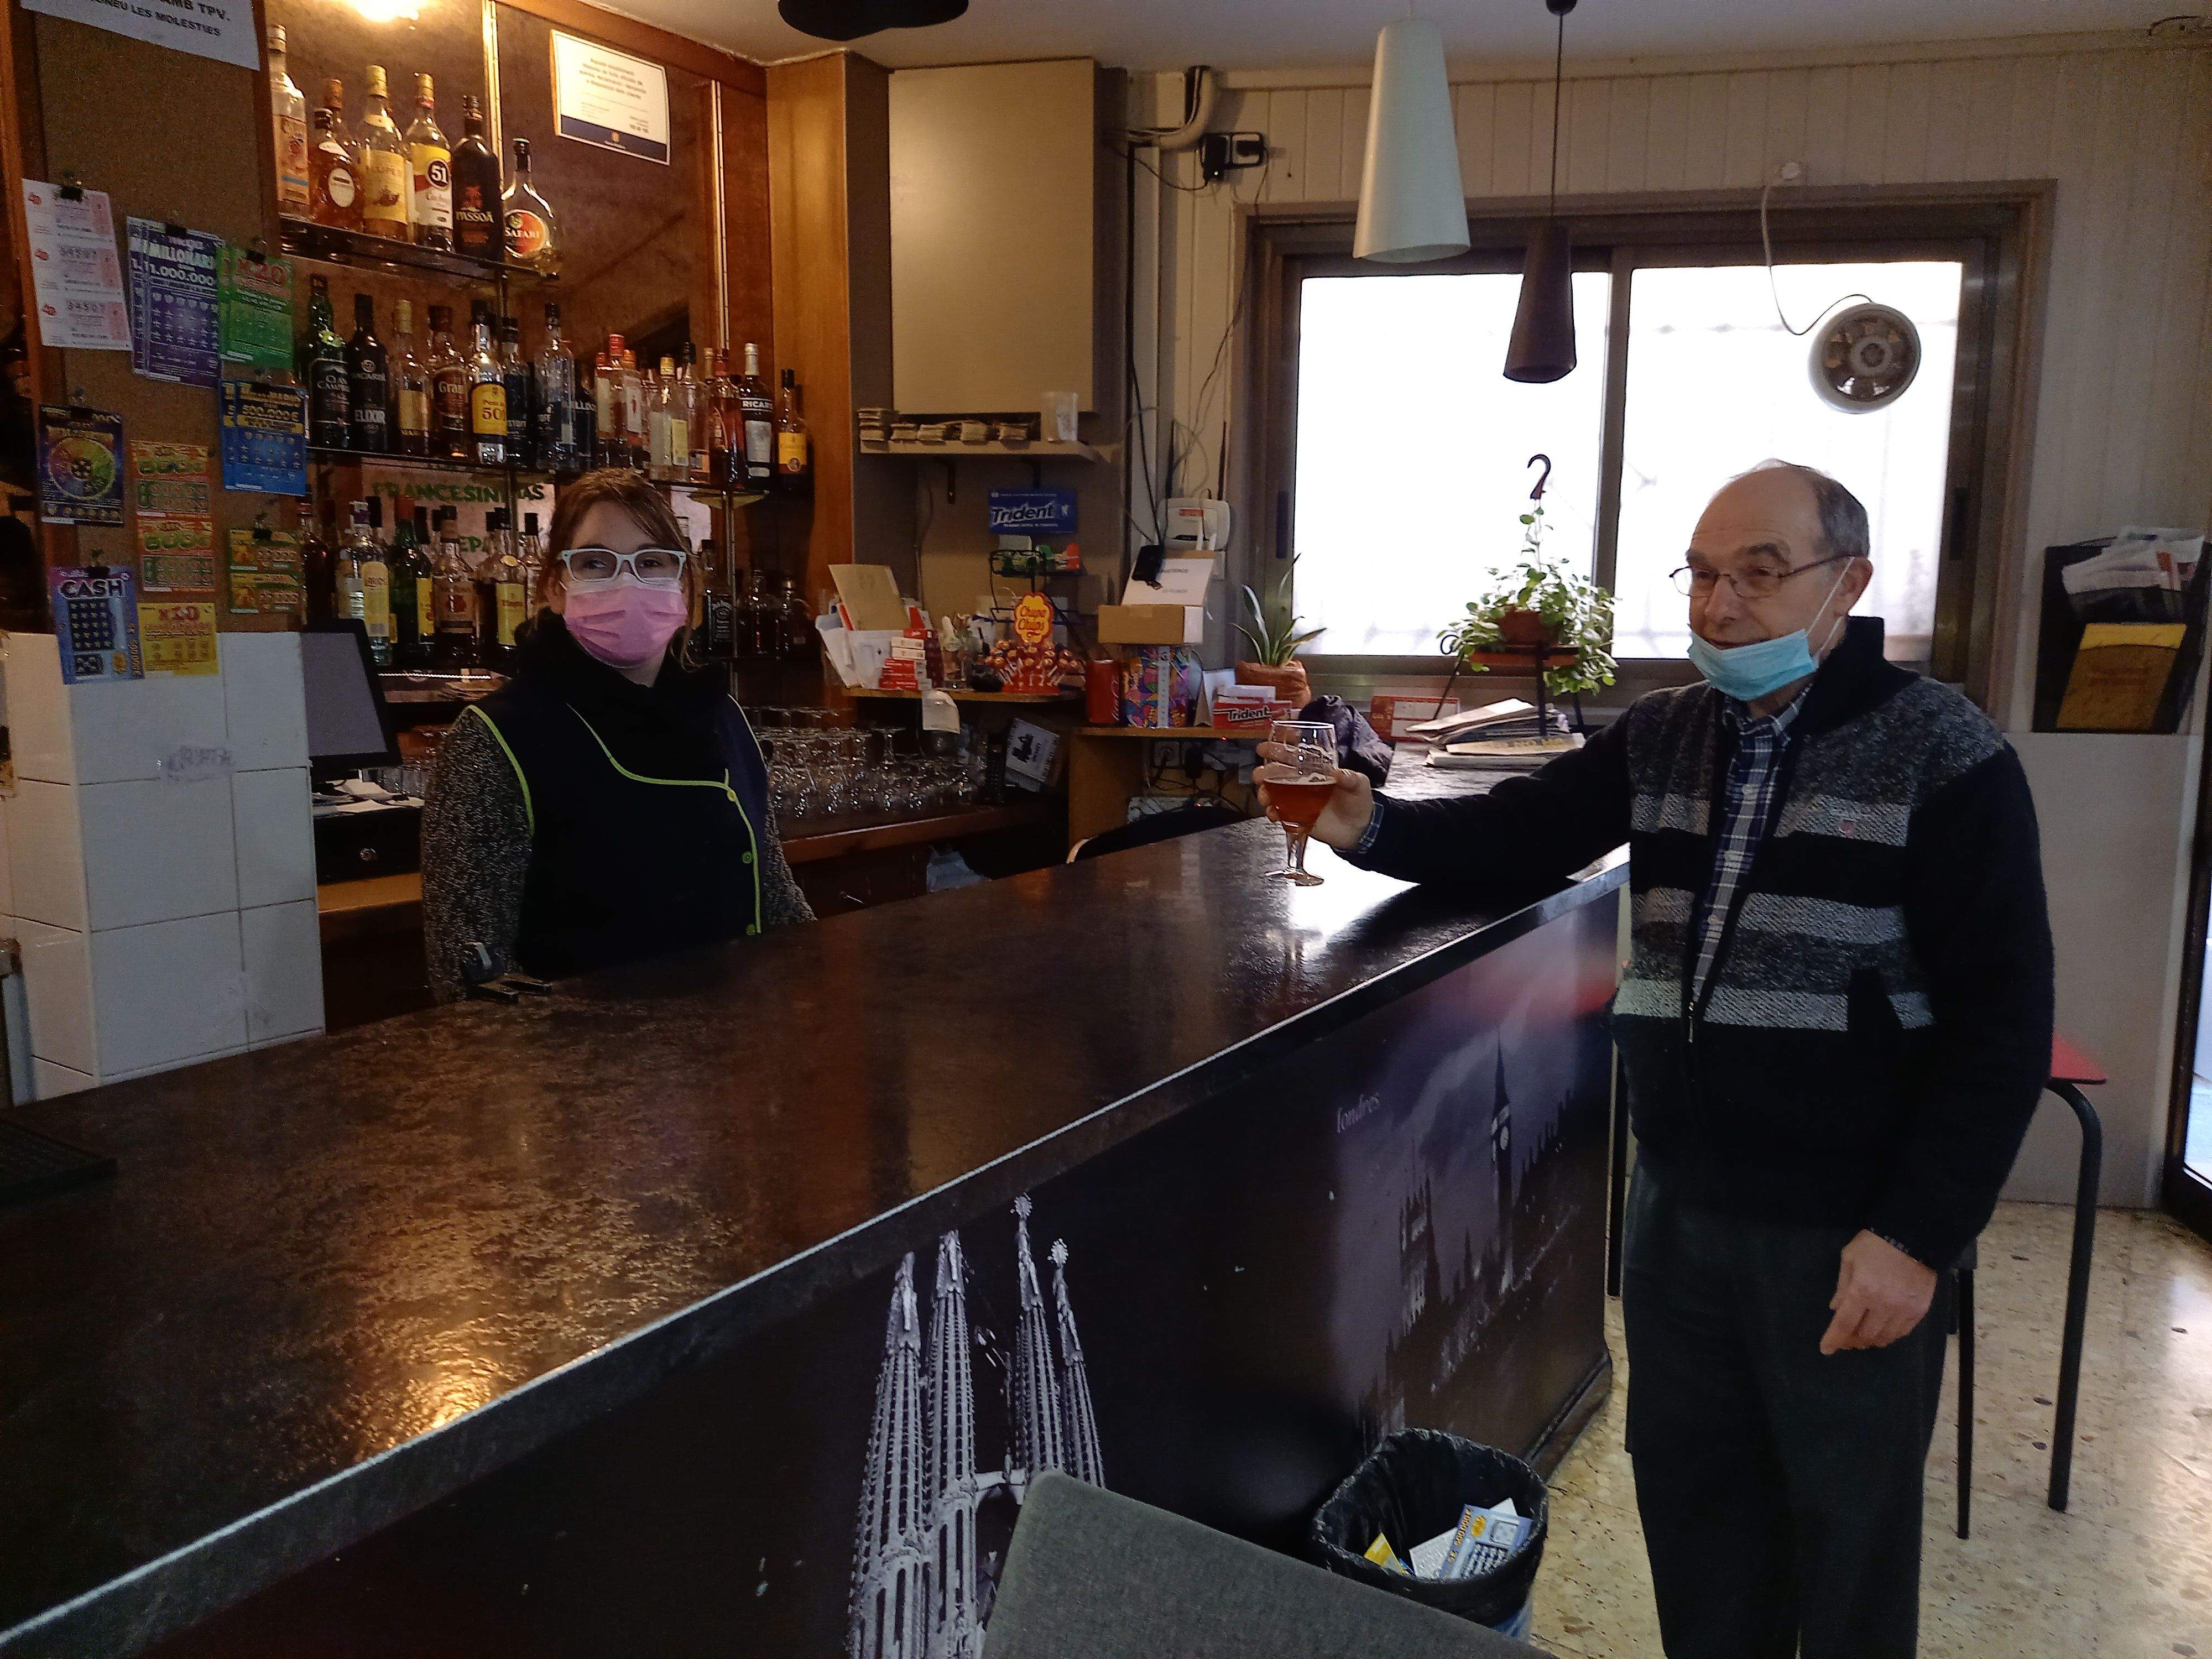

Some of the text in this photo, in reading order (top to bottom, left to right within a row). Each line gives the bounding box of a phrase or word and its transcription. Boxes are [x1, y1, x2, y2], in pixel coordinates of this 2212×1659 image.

[131, 4, 153, 18] LES
[155, 11, 221, 36] MOLESTIES
[197, 2, 231, 20] TPV.
[431, 165, 449, 184] 51
[504, 227, 540, 239] SAFARI
[990, 500, 1055, 525] Trident
[58, 578, 125, 600] CASH
[1228, 705, 1272, 721] Trident
